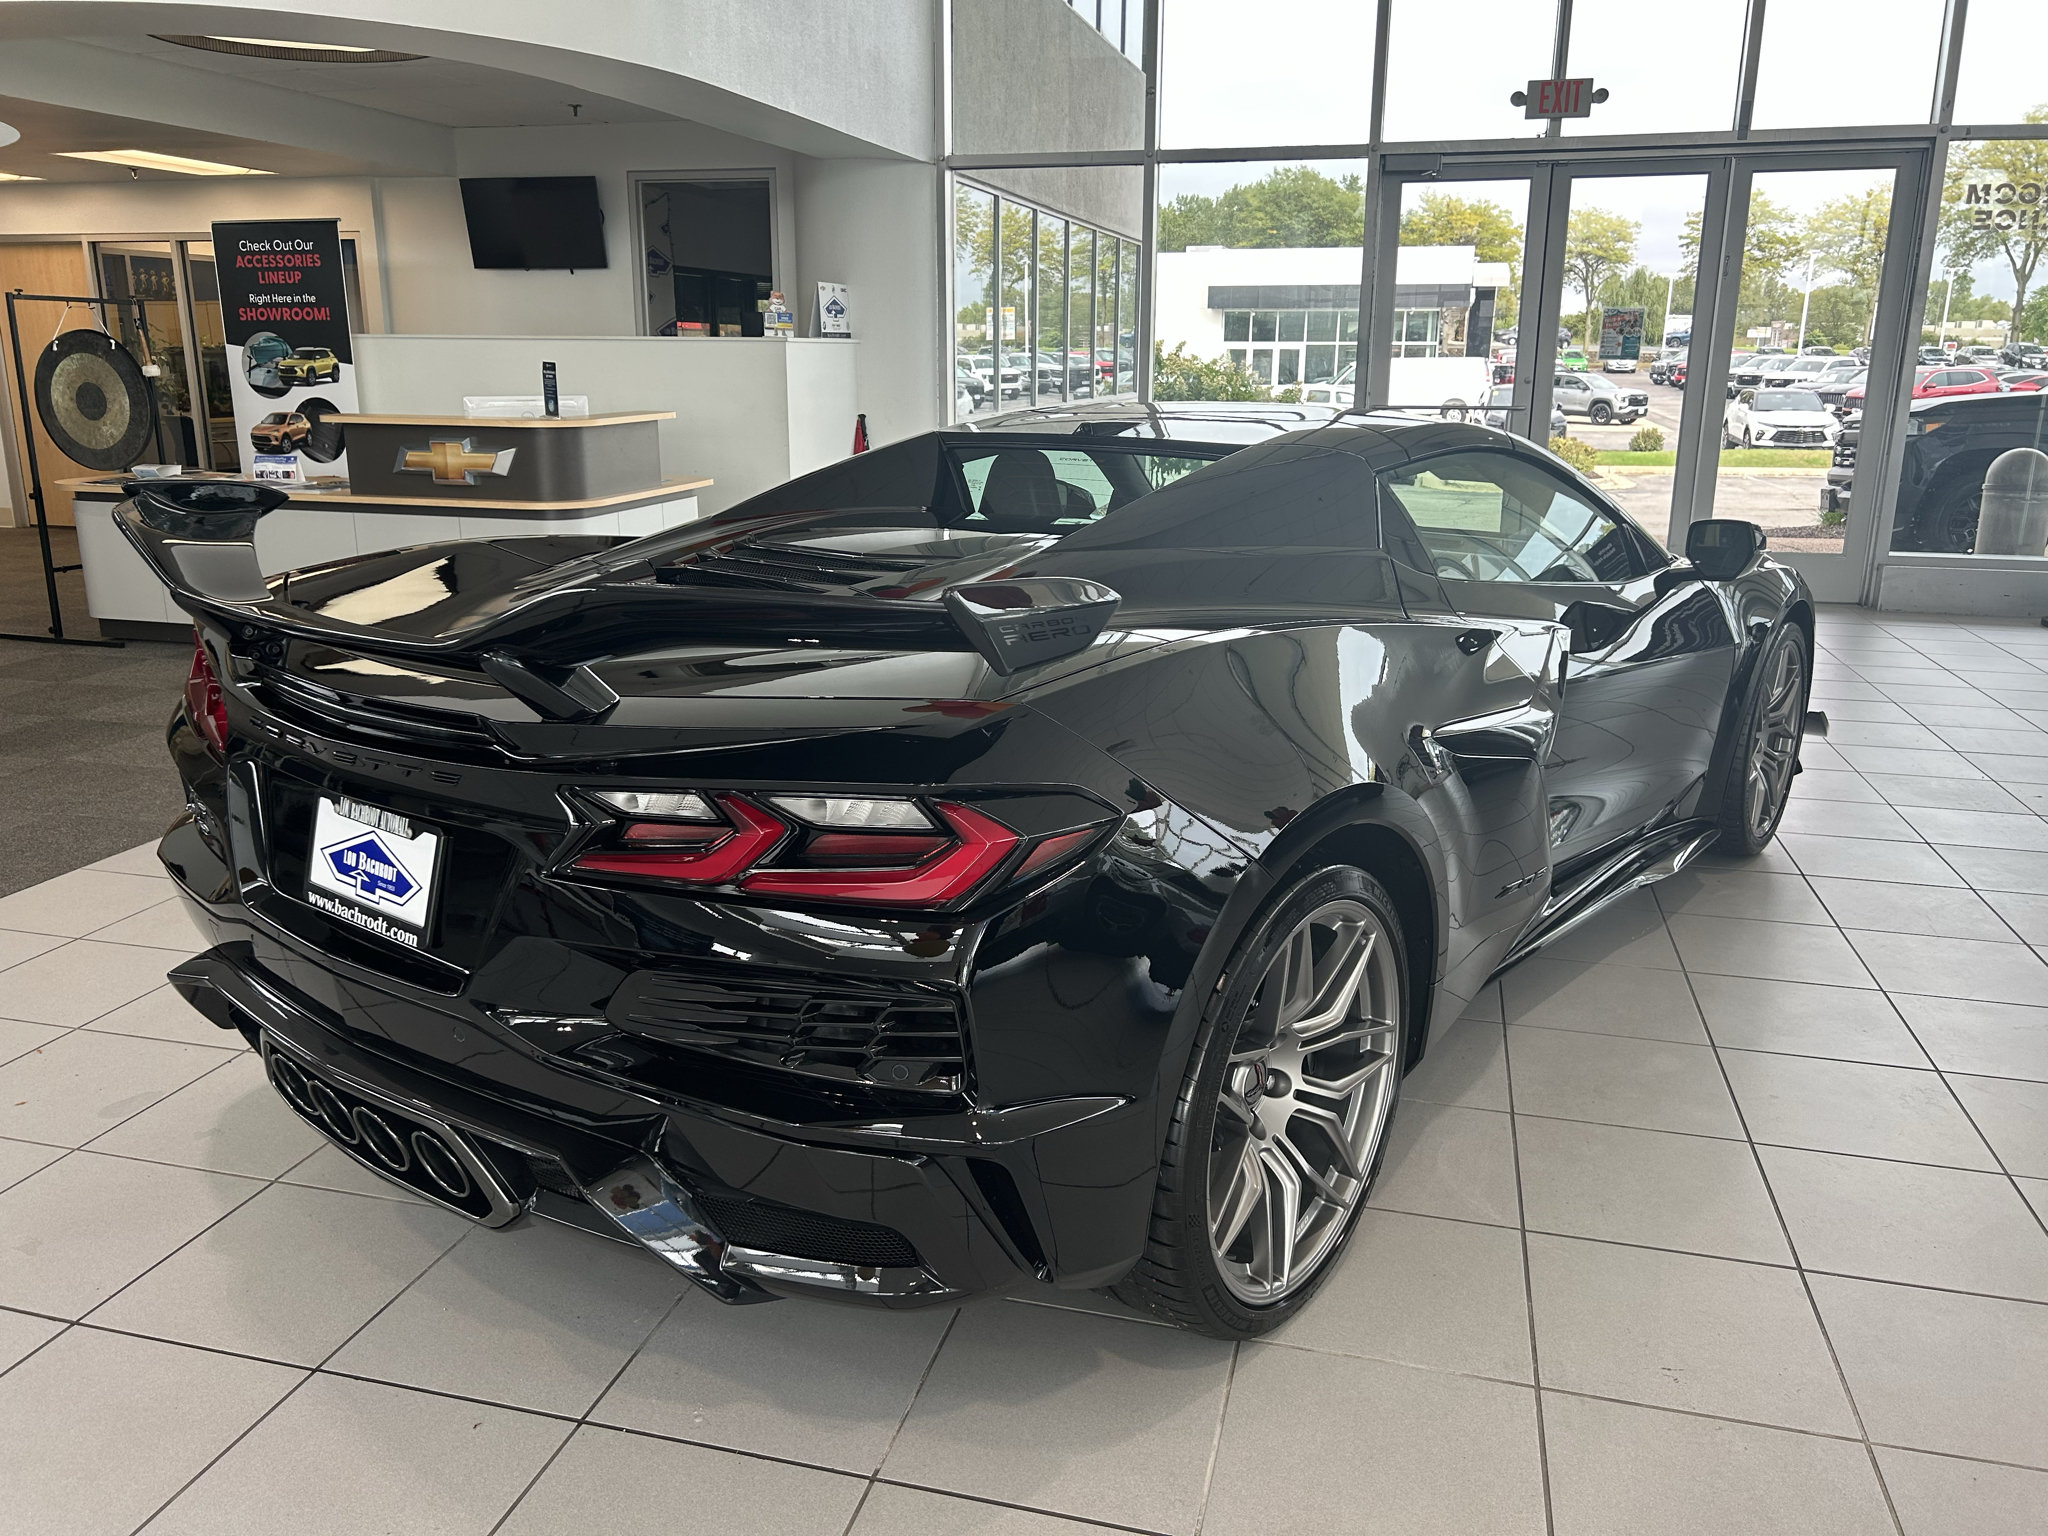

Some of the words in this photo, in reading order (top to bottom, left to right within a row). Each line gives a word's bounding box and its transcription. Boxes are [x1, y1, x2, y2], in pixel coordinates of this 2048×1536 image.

[1538, 80, 1584, 114] EXIT
[239, 240, 272, 251] Check
[273, 239, 293, 251] Out
[294, 239, 314, 251] Our
[235, 254, 322, 268] ACCESSORIES
[258, 271, 302, 284] LINEUP
[249, 293, 271, 305] Right
[271, 293, 292, 303] Here
[293, 293, 302, 303] in
[302, 293, 316, 303] the
[238, 307, 331, 321] SHOWROOM!
[1003, 625, 1091, 646] AERO
[343, 849, 357, 867] LOU
[358, 851, 398, 882] BACHRODT
[307, 891, 418, 948] www.bachrodt.com
